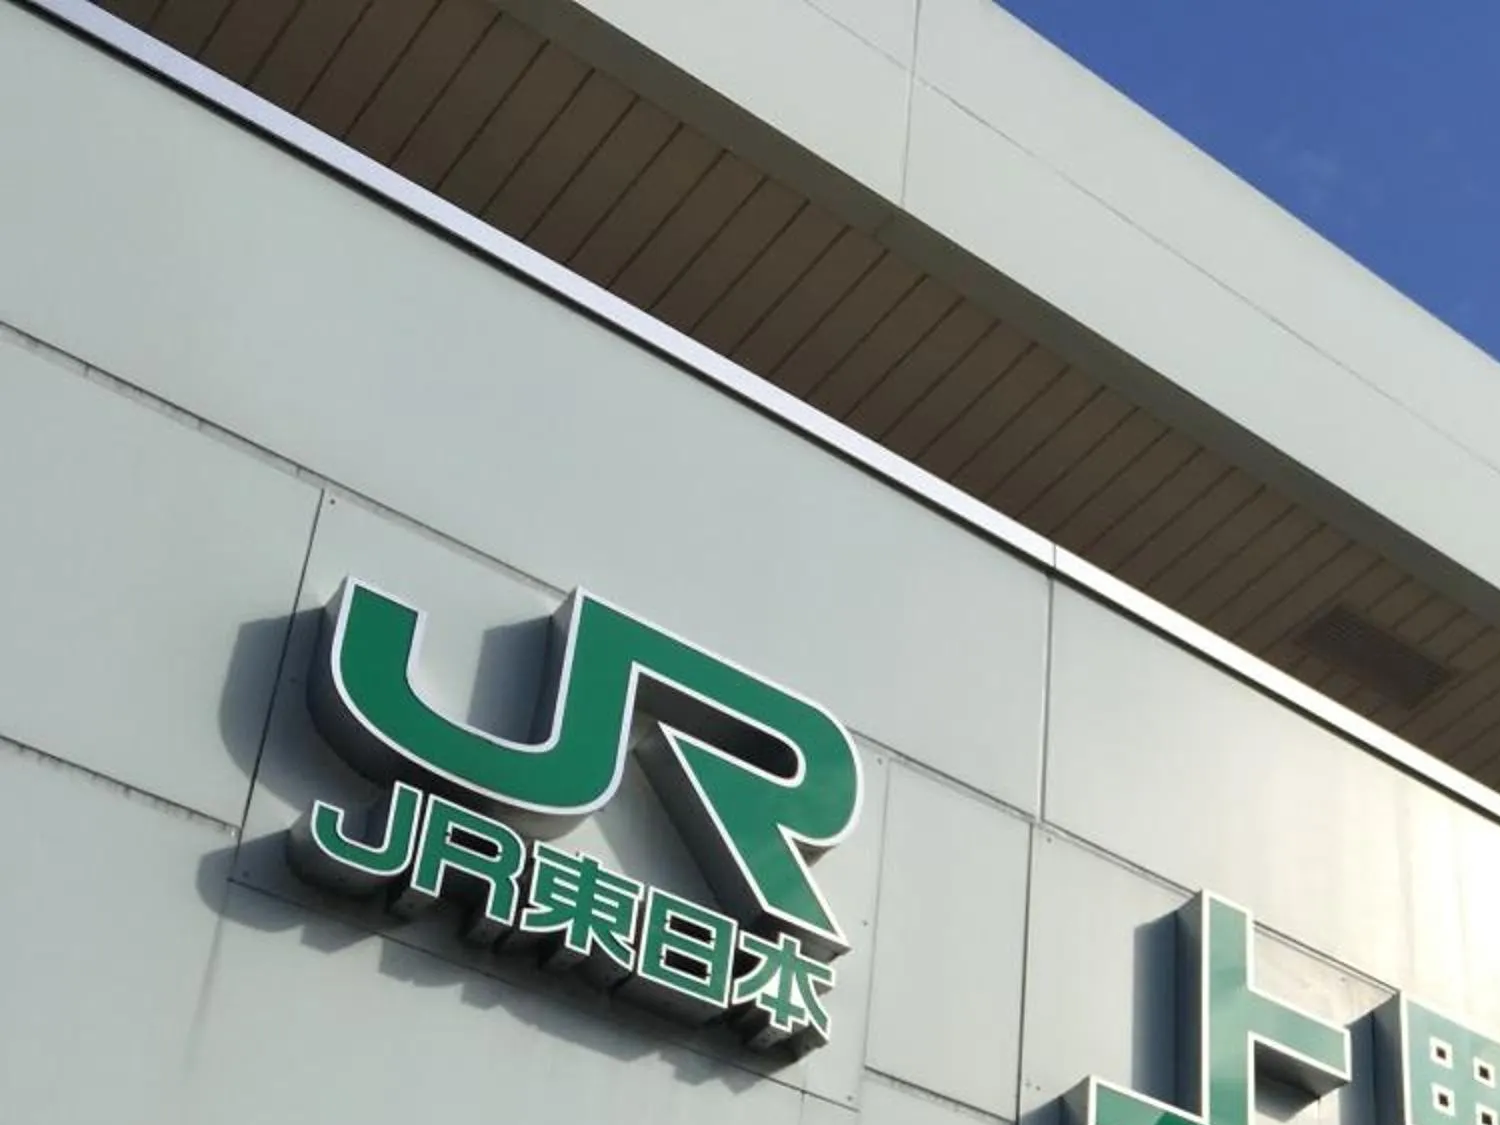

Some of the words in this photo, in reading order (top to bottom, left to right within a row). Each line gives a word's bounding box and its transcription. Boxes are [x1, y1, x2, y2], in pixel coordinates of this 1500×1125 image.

[311, 781, 836, 1041] JR東日本
[331, 576, 864, 948] JR
